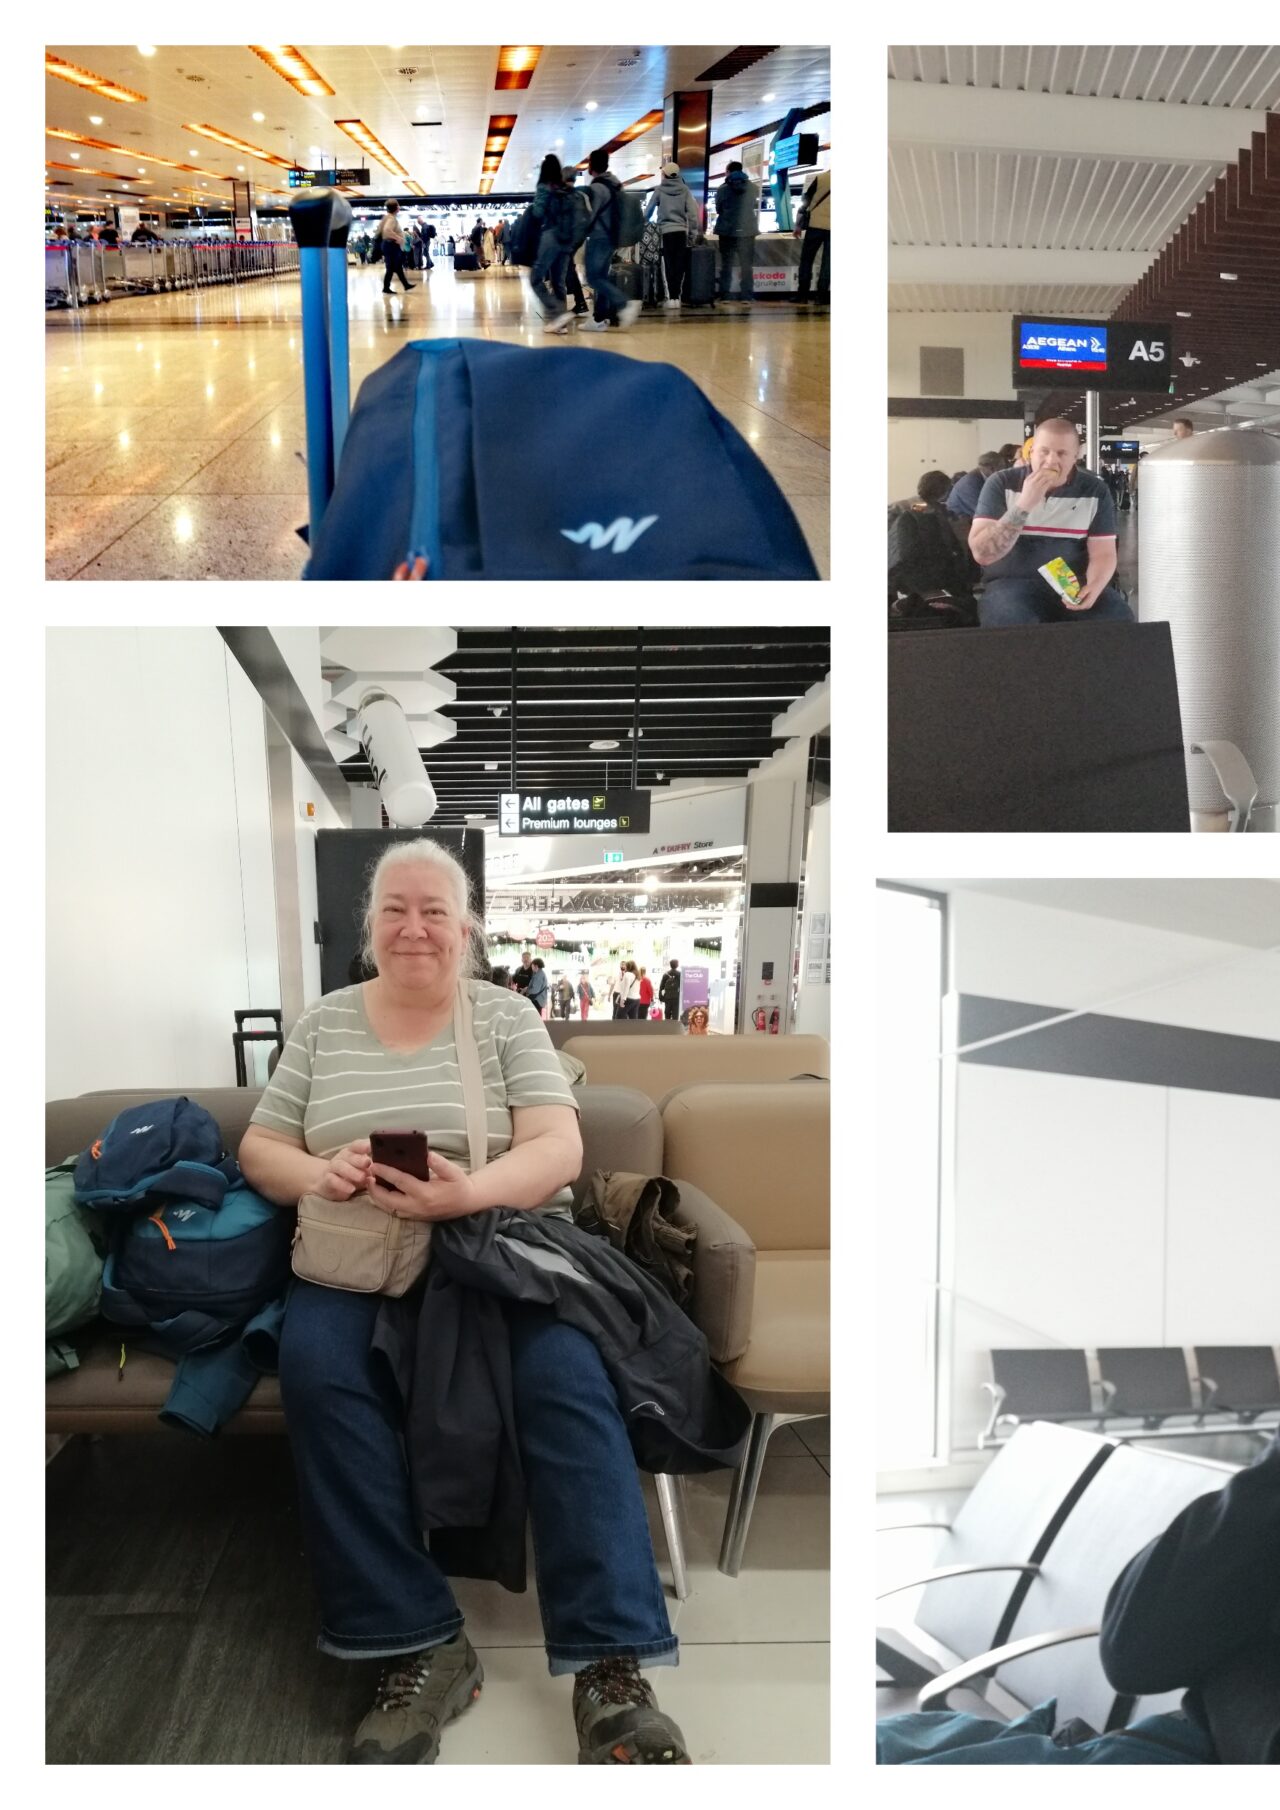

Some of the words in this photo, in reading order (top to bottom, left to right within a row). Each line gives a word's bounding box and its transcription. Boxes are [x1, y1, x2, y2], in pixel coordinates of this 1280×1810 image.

[1026, 336, 1088, 348] AEGEAN
[1128, 340, 1165, 362] A5
[522, 796, 541, 810] All
[547, 796, 590, 814] gates
[522, 817, 570, 829] Premium
[574, 817, 618, 831] lounges
[667, 842, 691, 853] DUFRY
[693, 840, 714, 849] Store
